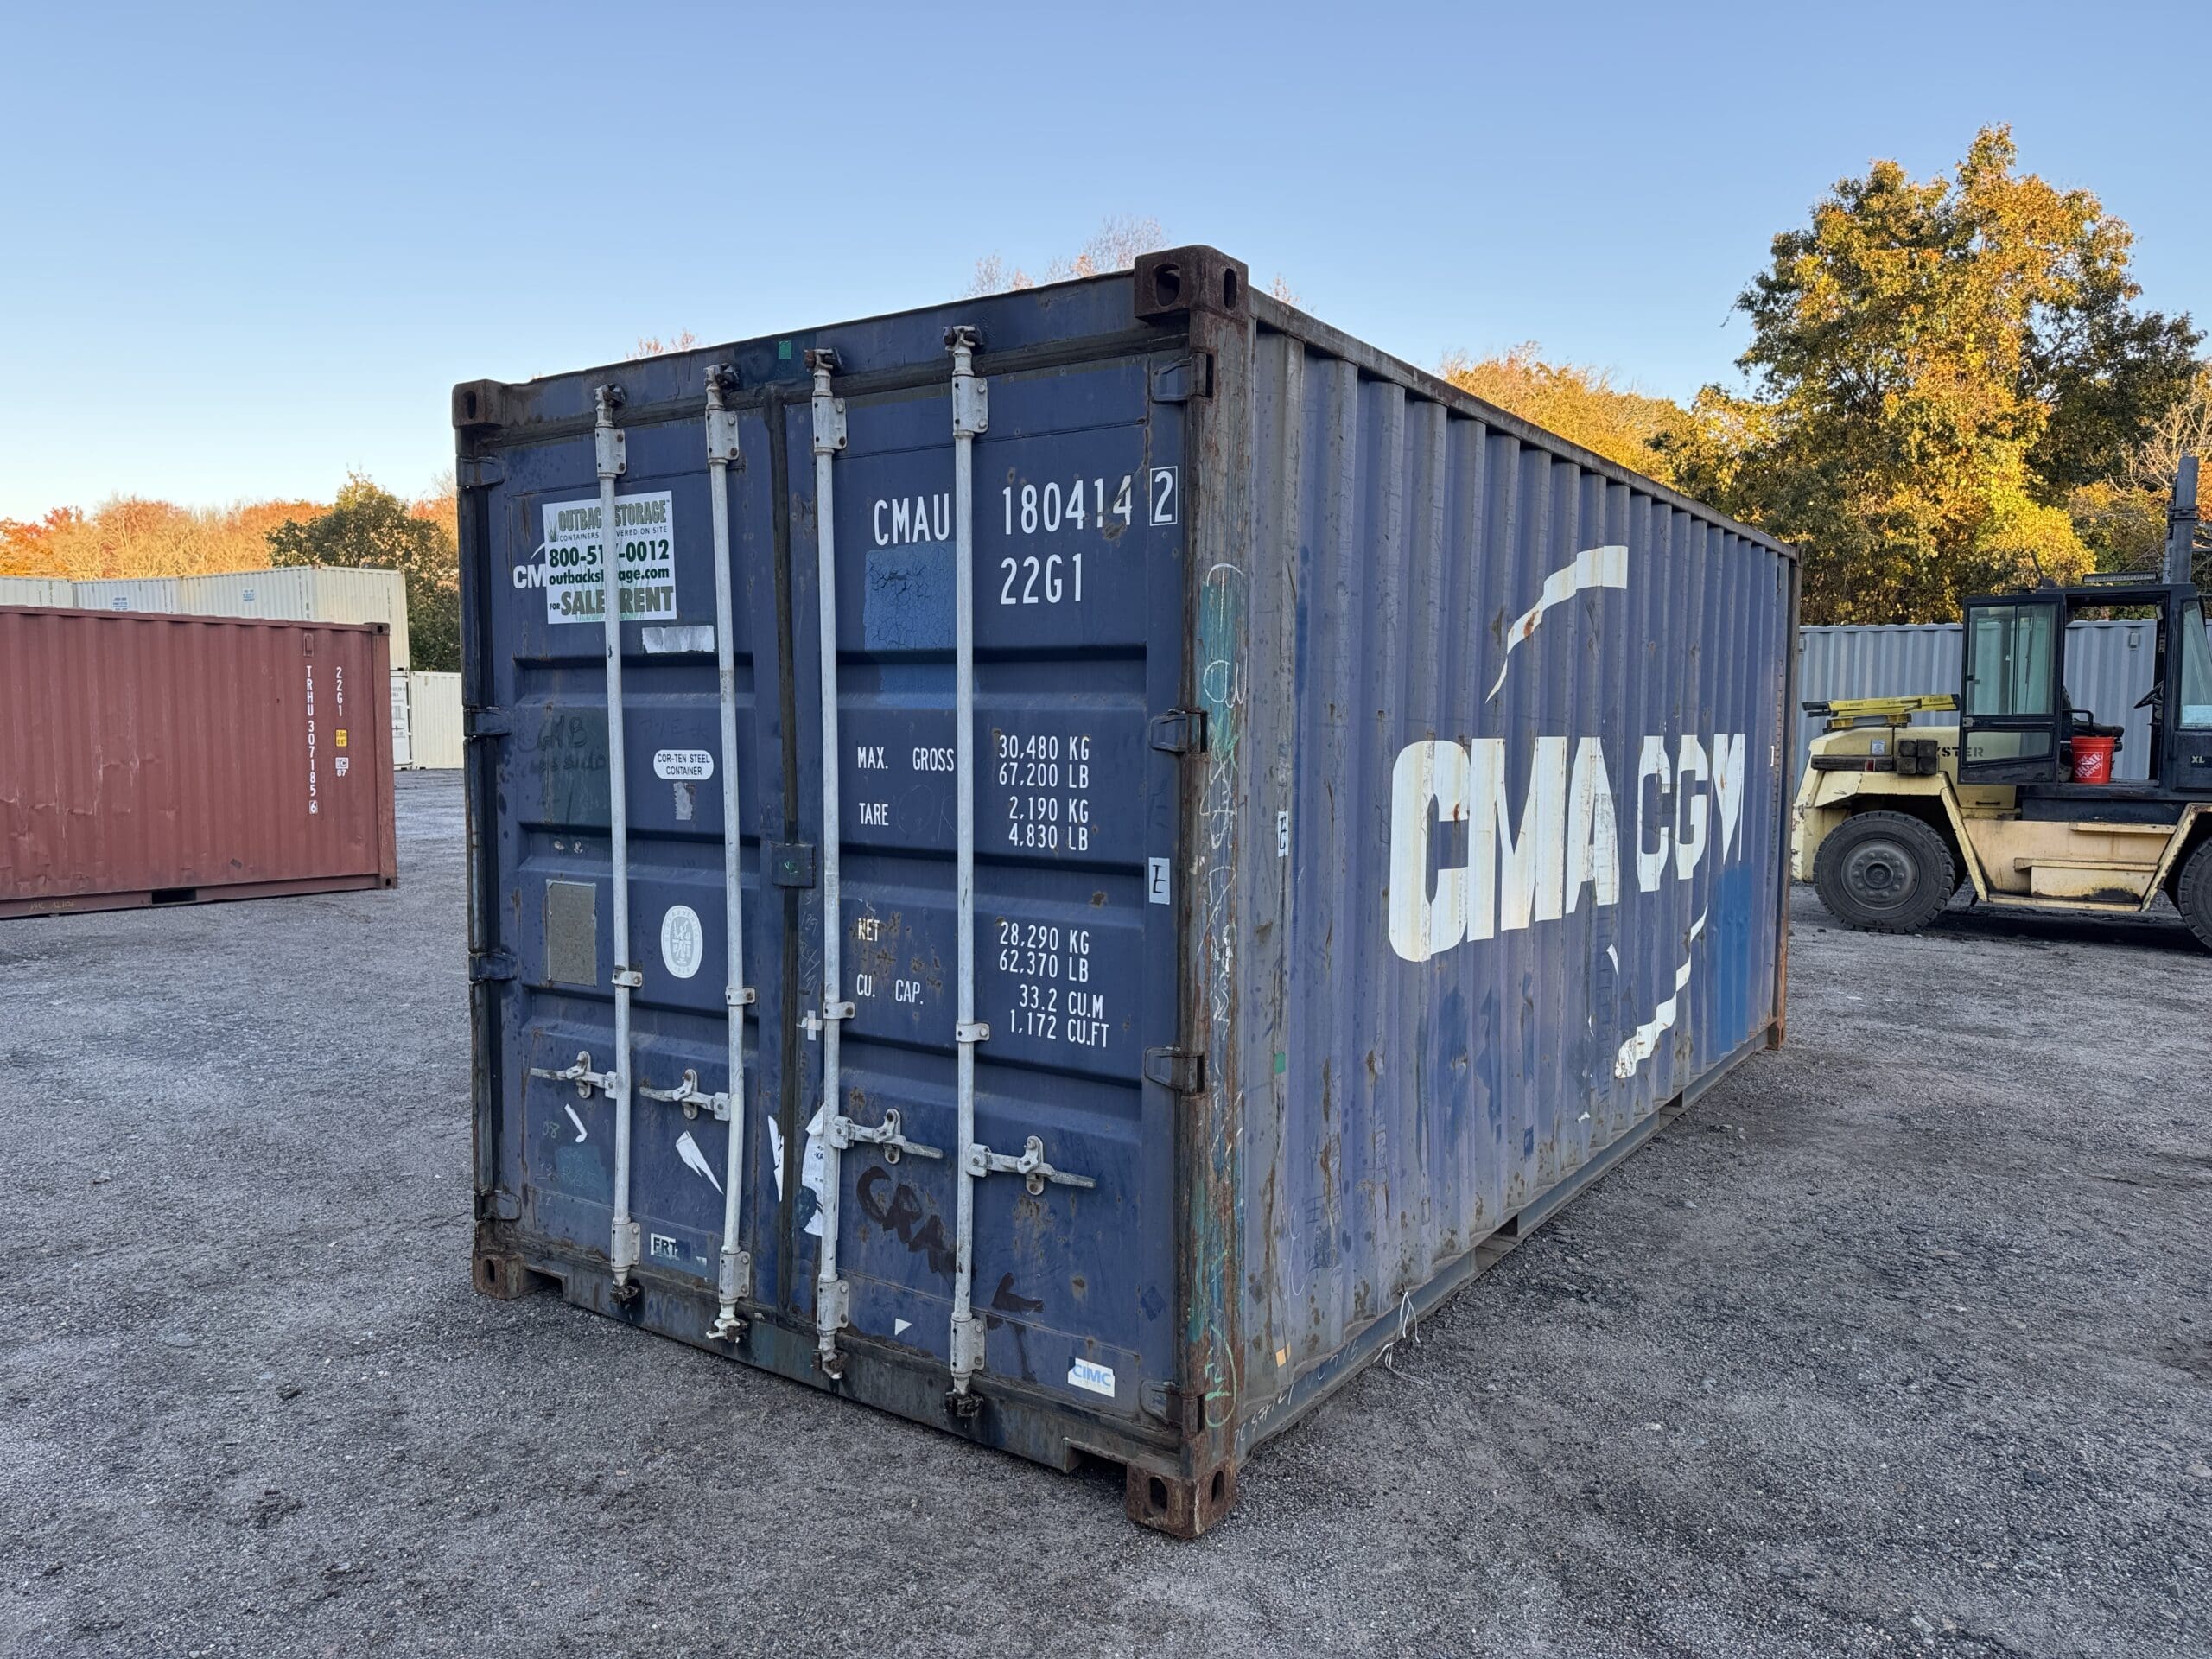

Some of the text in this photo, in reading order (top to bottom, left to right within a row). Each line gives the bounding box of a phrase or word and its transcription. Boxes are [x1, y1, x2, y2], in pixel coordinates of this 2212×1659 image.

[557, 506, 602, 532] OUTBAC
[874, 470, 1174, 546] CMAU 180414 2
[559, 531, 600, 542] CONTAINERS
[549, 539, 670, 568] 800-51-0012
[512, 563, 547, 589] CM
[549, 567, 670, 586] outbackstage.com
[1000, 552, 1082, 605] 22G1
[561, 589, 606, 616] SALE
[619, 585, 674, 613] RENT
[308, 720, 317, 797] 307185
[657, 753, 710, 764] COR-TEN STEEL
[857, 734, 1090, 772] MAX. GROSS 30,480 KG
[2191, 755, 2206, 764] XL
[665, 766, 702, 776] CONTAINER
[999, 762, 1089, 789] 67,200 LB
[309, 800, 318, 814] 6
[858, 796, 1089, 826] TARE 2,190 KG
[1008, 823, 1088, 851] 4,830 LB
[1388, 735, 1620, 963] CMA
[858, 918, 1090, 955] NET 28,290 KG
[999, 948, 1089, 982] 62,370 LB
[856, 973, 1103, 1020] CU. CAP. 33.2 CU.M
[1009, 1008, 1109, 1048] 1,172 CU.FT
[1072, 1363, 1111, 1387] CIMC
